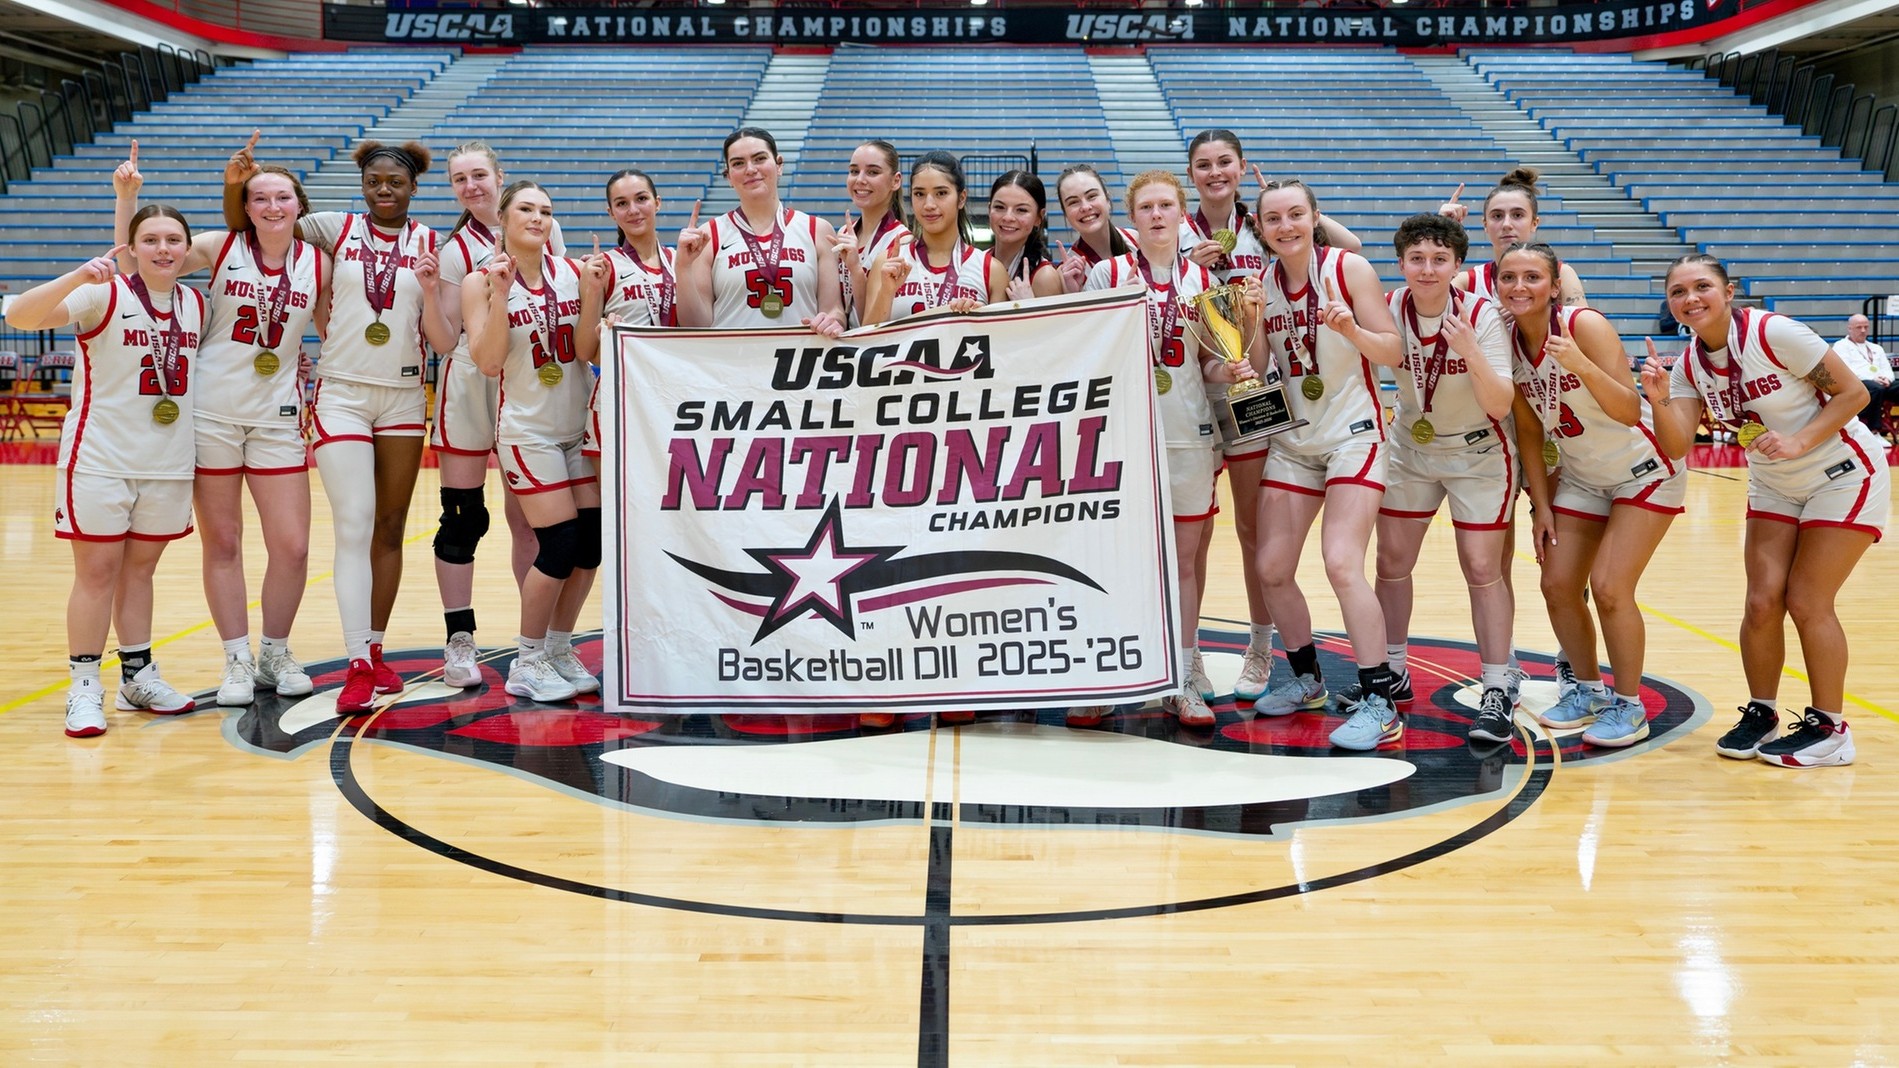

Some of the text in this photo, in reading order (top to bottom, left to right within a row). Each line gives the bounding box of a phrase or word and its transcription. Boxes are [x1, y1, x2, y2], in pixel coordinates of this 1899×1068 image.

[385, 13, 1007, 38] USCAA NATIONAL CHAMPIONSHIPS
[1066, 0, 1695, 39] USCAA NATIONAL CHAMPIONSHIPS
[745, 267, 793, 309] 55
[231, 304, 290, 350] 25
[771, 335, 995, 390] USCAA
[673, 376, 1113, 431] SMALL COLLEGE
[1549, 372, 1557, 410] USCAA
[660, 416, 1123, 510] NATIONAL
[928, 500, 1121, 532] CHAMPIONS
[861, 622, 874, 630] TM
[905, 597, 1077, 639] Women's
[718, 635, 1143, 681] Basketball DII 2025-'26
